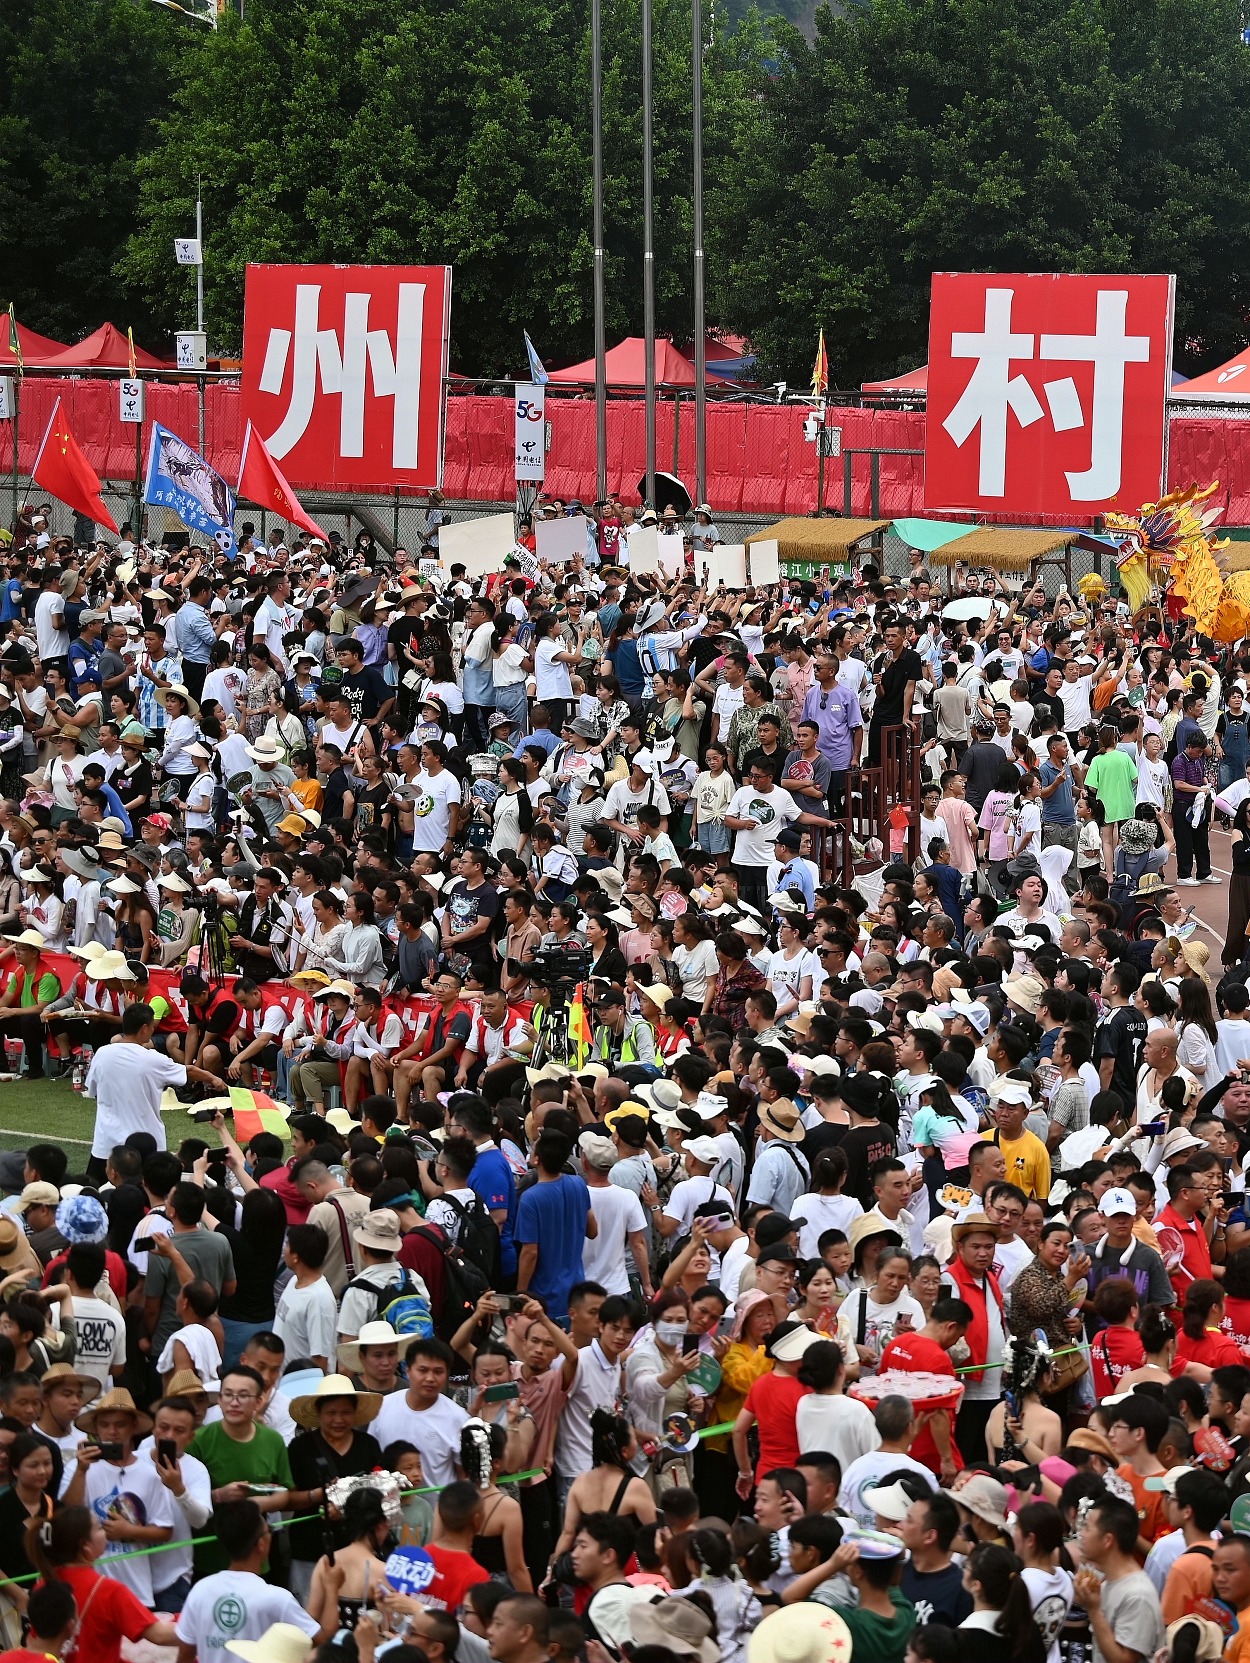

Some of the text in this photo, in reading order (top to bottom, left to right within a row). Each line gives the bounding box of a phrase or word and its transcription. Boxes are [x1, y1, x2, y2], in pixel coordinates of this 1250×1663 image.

[258, 282, 426, 470] 州
[123, 383, 139, 397] 5G
[942, 288, 1151, 502] 村
[516, 401, 543, 422] 5G
[516, 455, 542, 464] 中国电信
[1132, 1037, 1142, 1068] 7
[76, 1321, 108, 1342] LOW
[91, 1338, 113, 1354] ROCK
